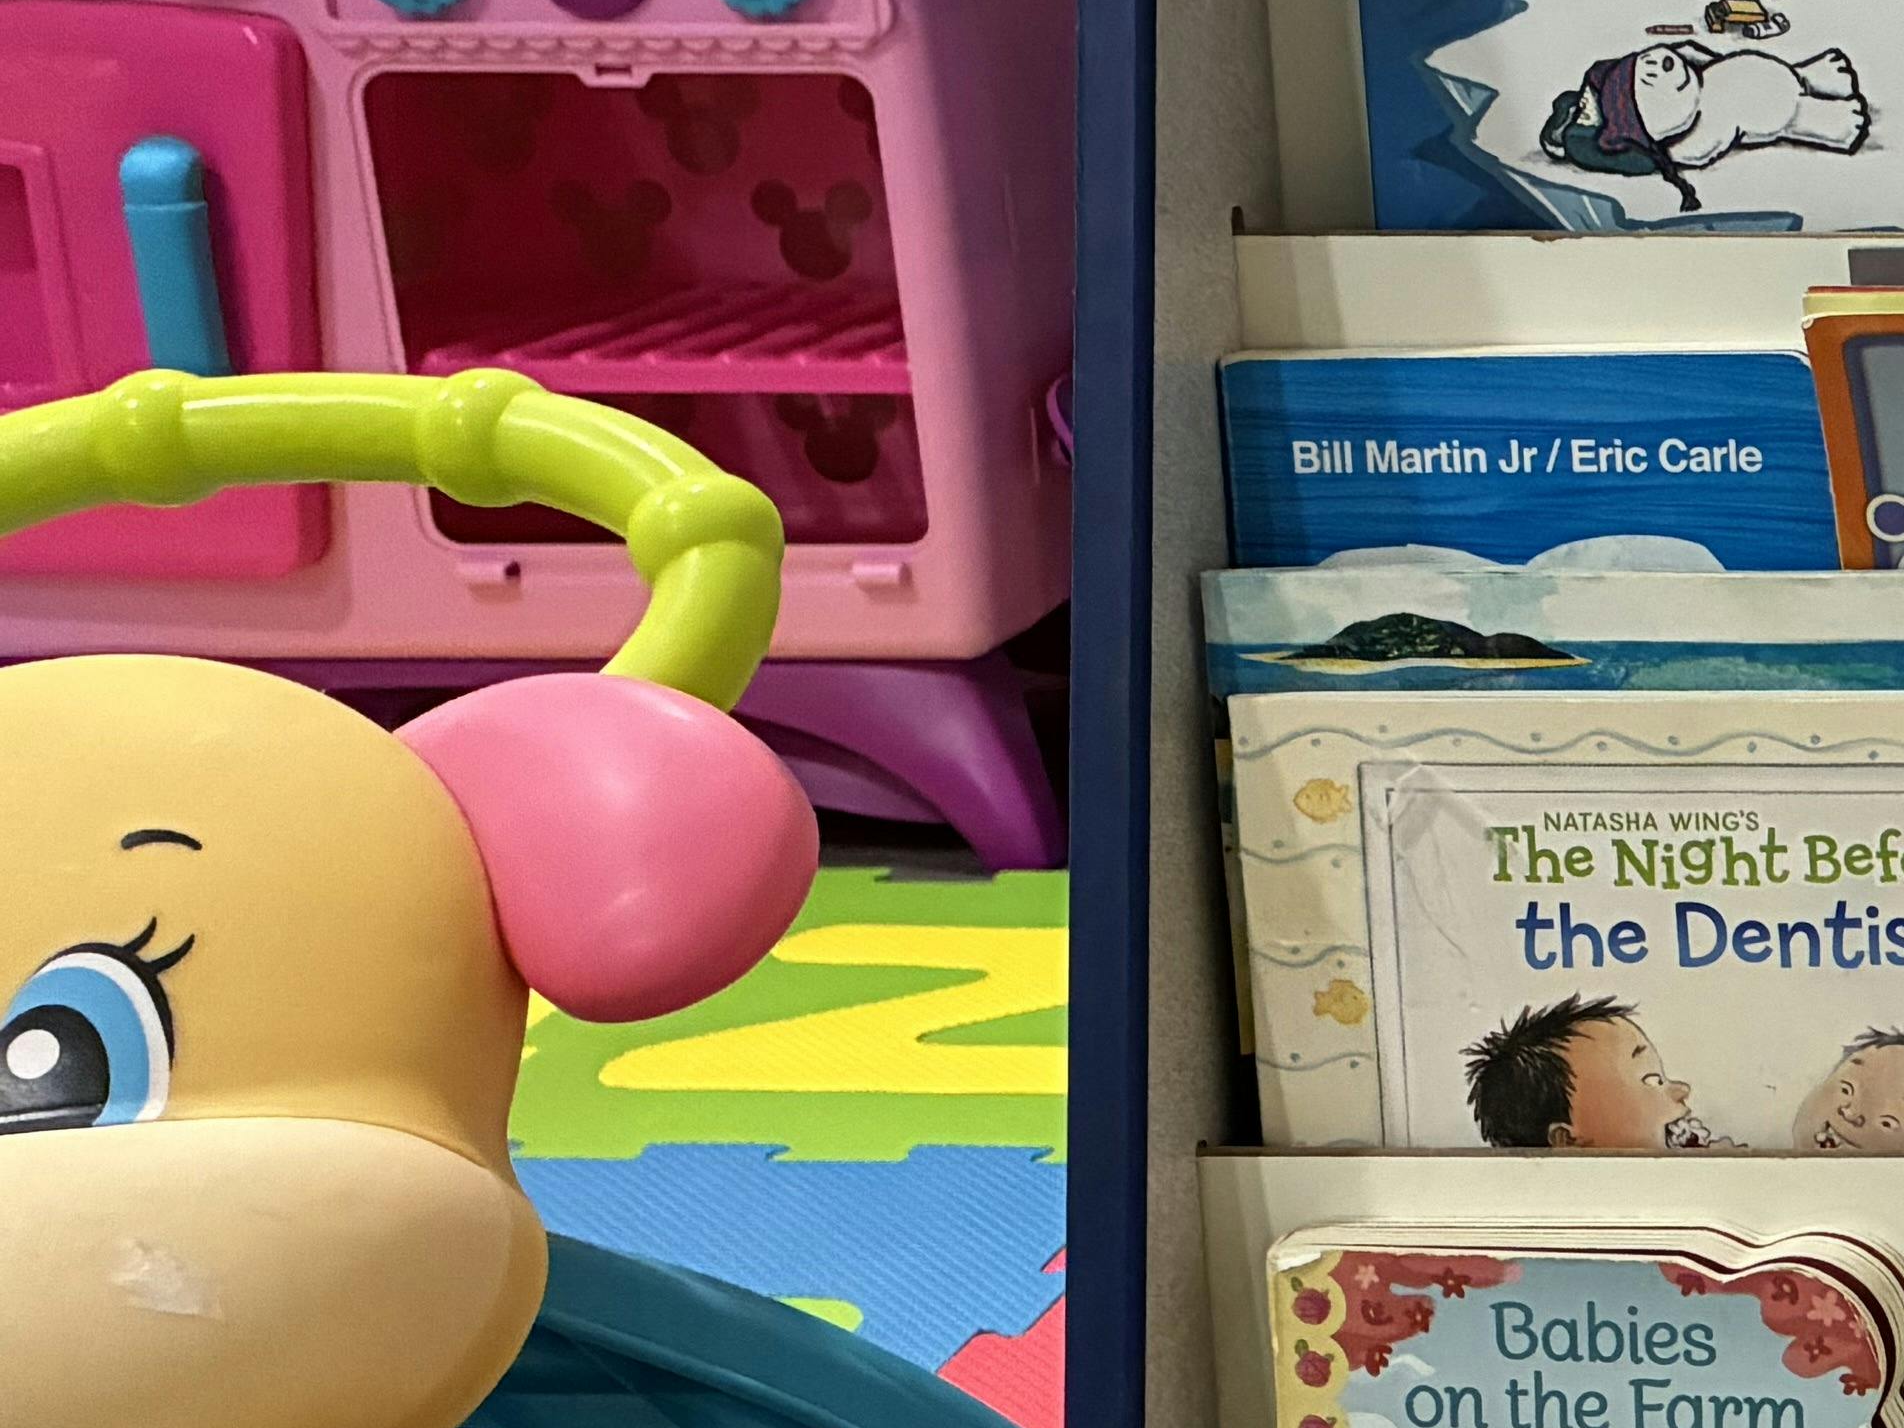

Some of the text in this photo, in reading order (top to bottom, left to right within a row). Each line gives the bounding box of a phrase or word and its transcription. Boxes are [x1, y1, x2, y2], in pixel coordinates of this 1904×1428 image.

[1292, 440, 1353, 473] Bill
[1366, 439, 1487, 473] Martin
[1498, 439, 1538, 473] Jr
[1571, 438, 1648, 473] Eric
[1658, 437, 1763, 473] Carle
[1543, 810, 1761, 833] NATASHA WING'S
[1484, 825, 1595, 884] The
[1612, 826, 1790, 891] Night
[1516, 900, 1649, 969] the
[1489, 1300, 1719, 1367] Babies
